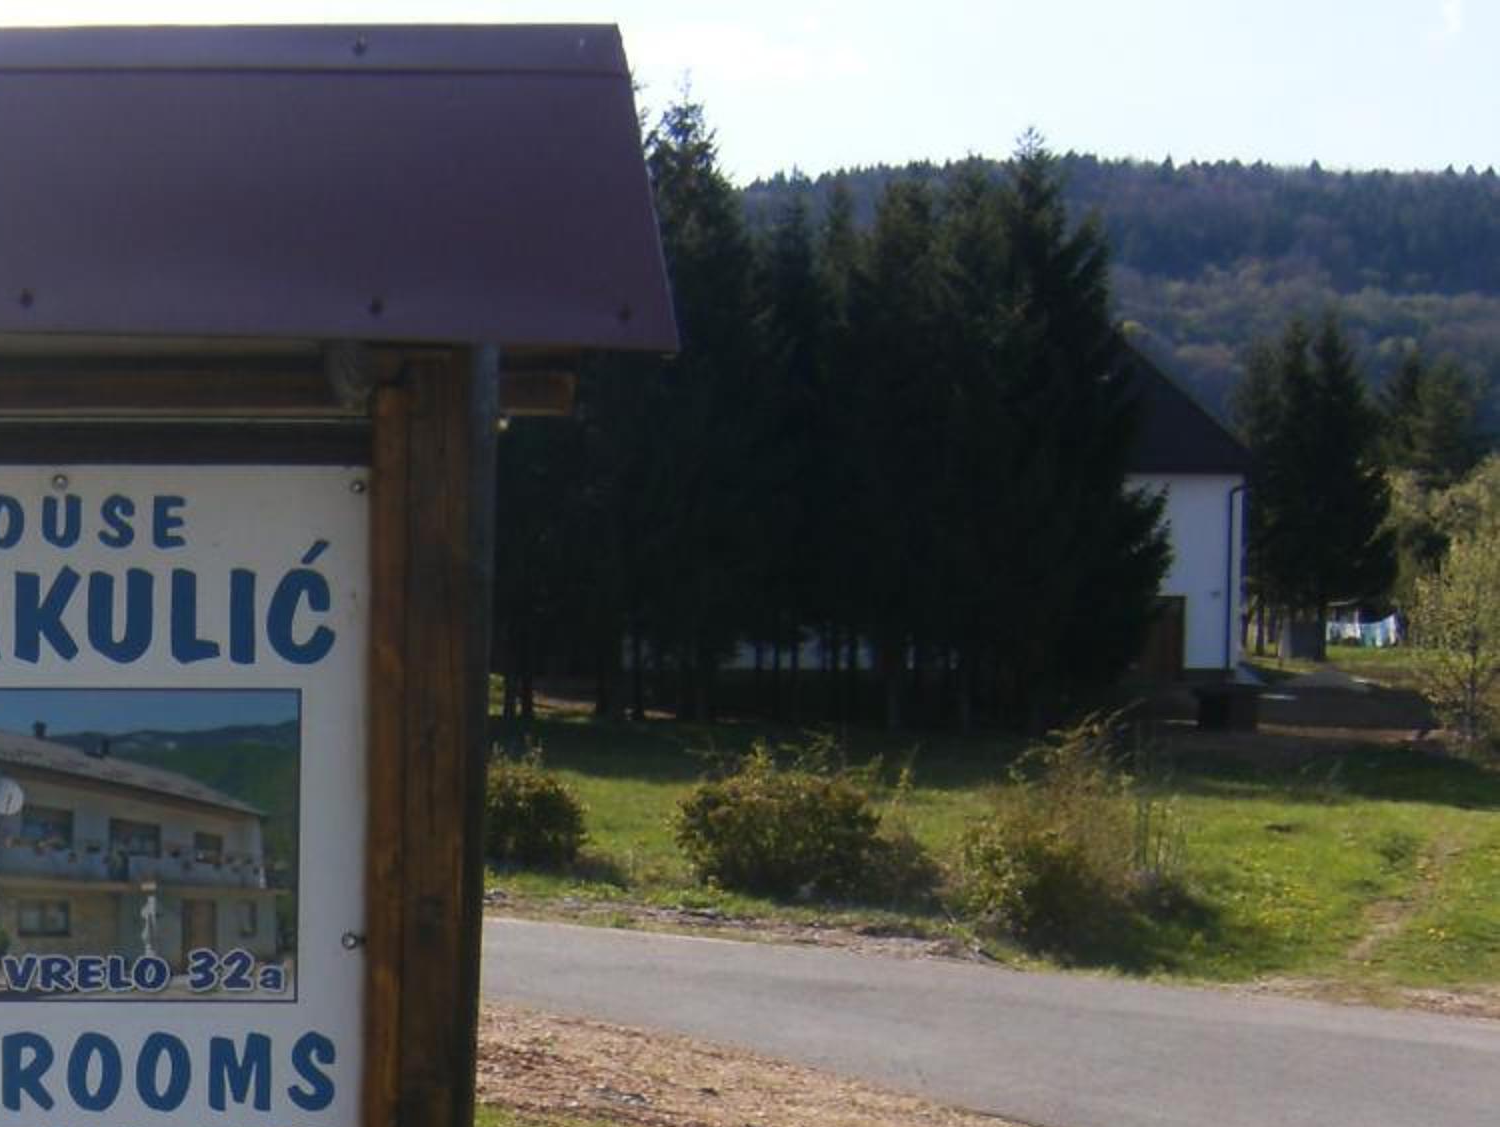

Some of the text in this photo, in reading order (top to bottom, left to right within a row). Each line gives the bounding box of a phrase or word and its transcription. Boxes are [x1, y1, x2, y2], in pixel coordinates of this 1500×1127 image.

[2, 948, 286, 992] VRELO 32a
[1, 1031, 336, 1112] ROOMS
